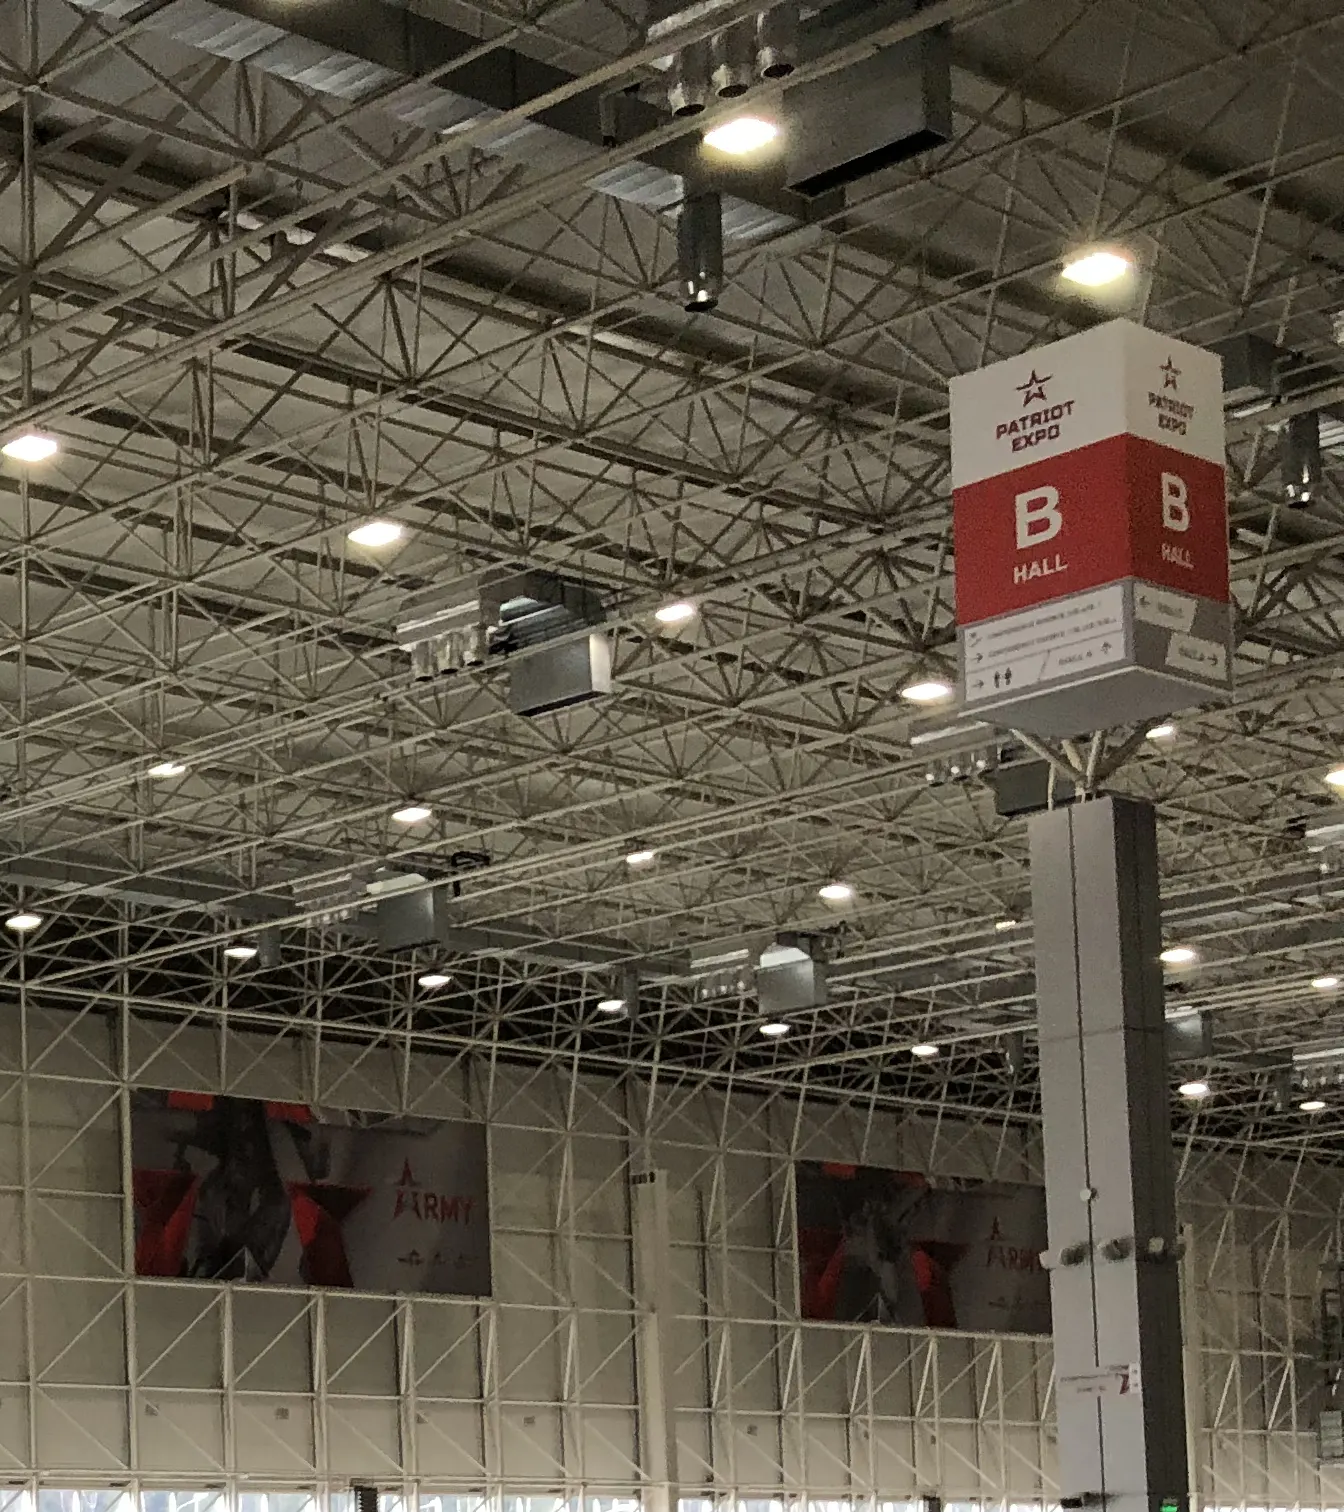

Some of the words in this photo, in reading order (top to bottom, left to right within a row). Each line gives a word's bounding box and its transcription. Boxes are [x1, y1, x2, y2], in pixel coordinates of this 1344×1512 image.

[996, 400, 1076, 439] PATRIOT
[1148, 391, 1195, 420] PATRIOT
[1011, 424, 1061, 453] EXPO
[1157, 413, 1187, 436] EXPO
[1014, 485, 1063, 550] B
[1161, 471, 1191, 532] B
[1013, 553, 1068, 585] HALL
[1160, 542, 1195, 570] HALL
[393, 1156, 475, 1224] ARMY
